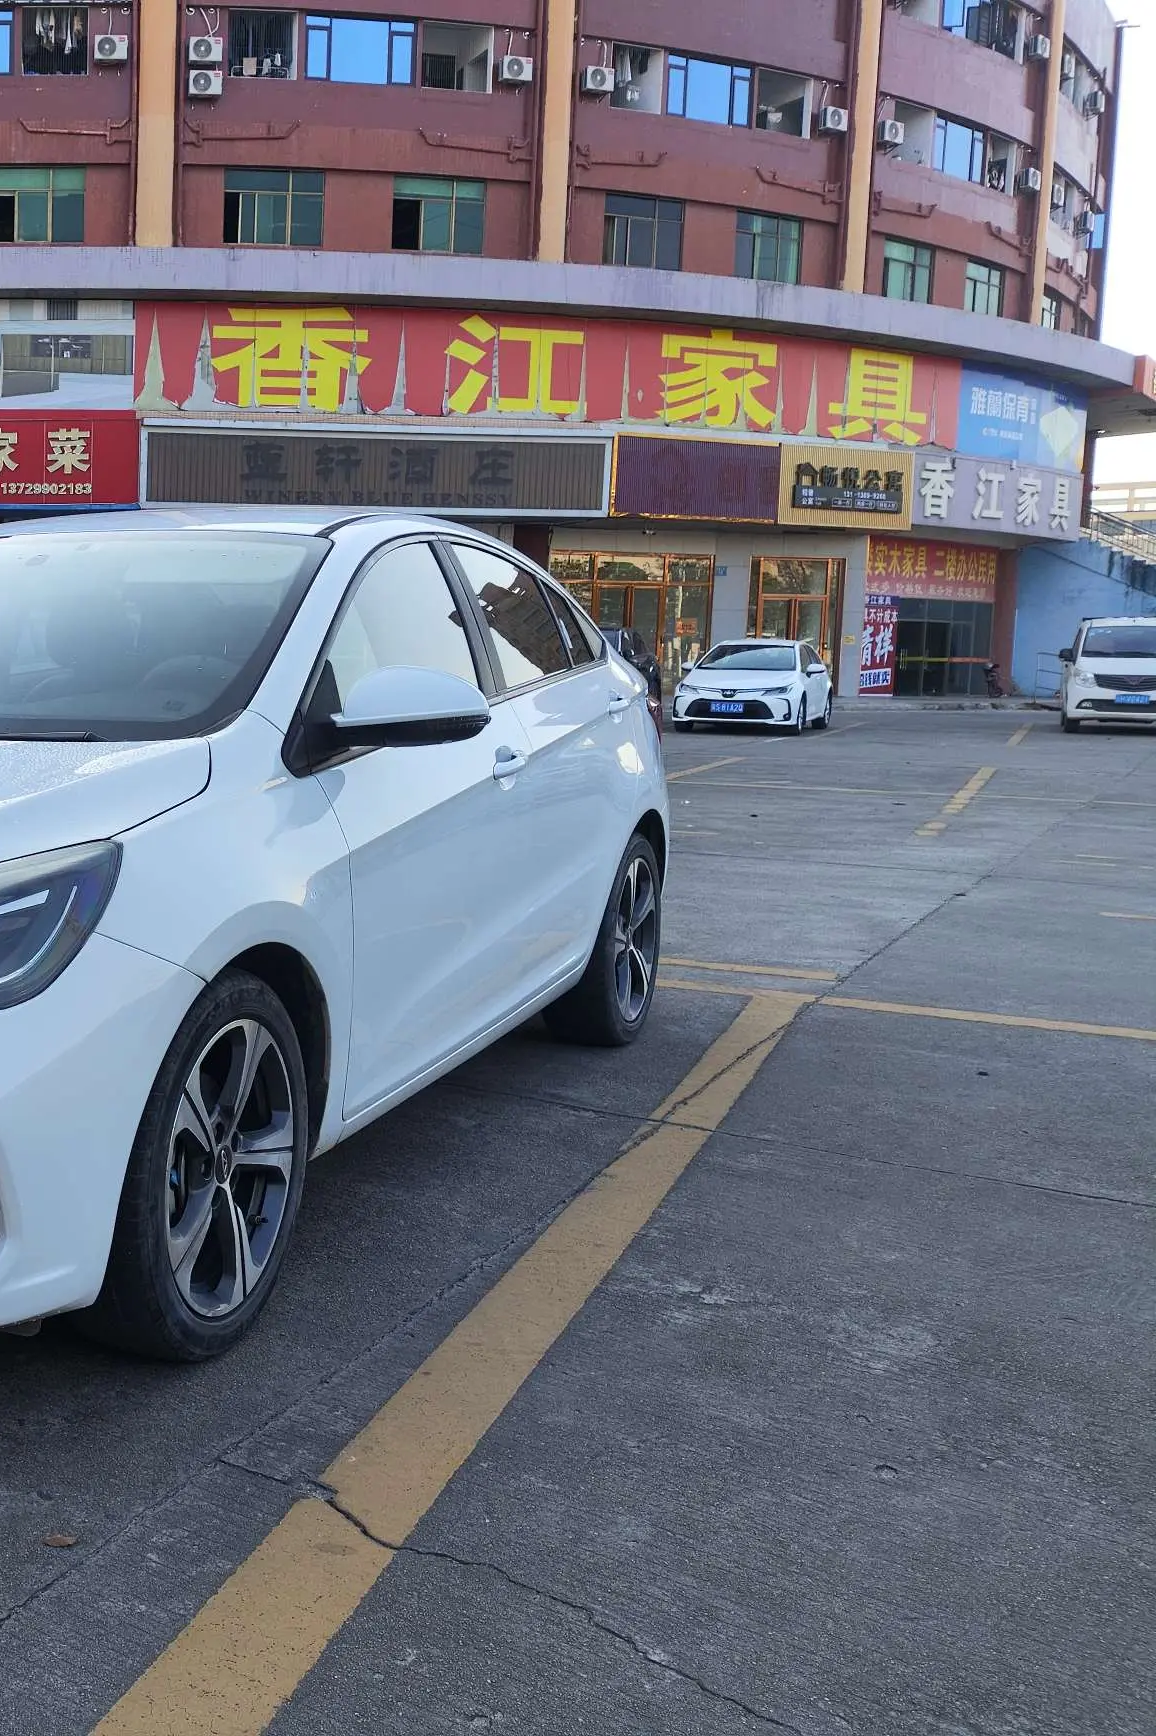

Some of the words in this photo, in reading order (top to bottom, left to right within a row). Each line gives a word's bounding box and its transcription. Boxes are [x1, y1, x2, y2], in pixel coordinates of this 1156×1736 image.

[212, 306, 927, 446] 香江家具
[351, 490, 413, 504] BLUE
[919, 459, 1072, 532] 香江家具
